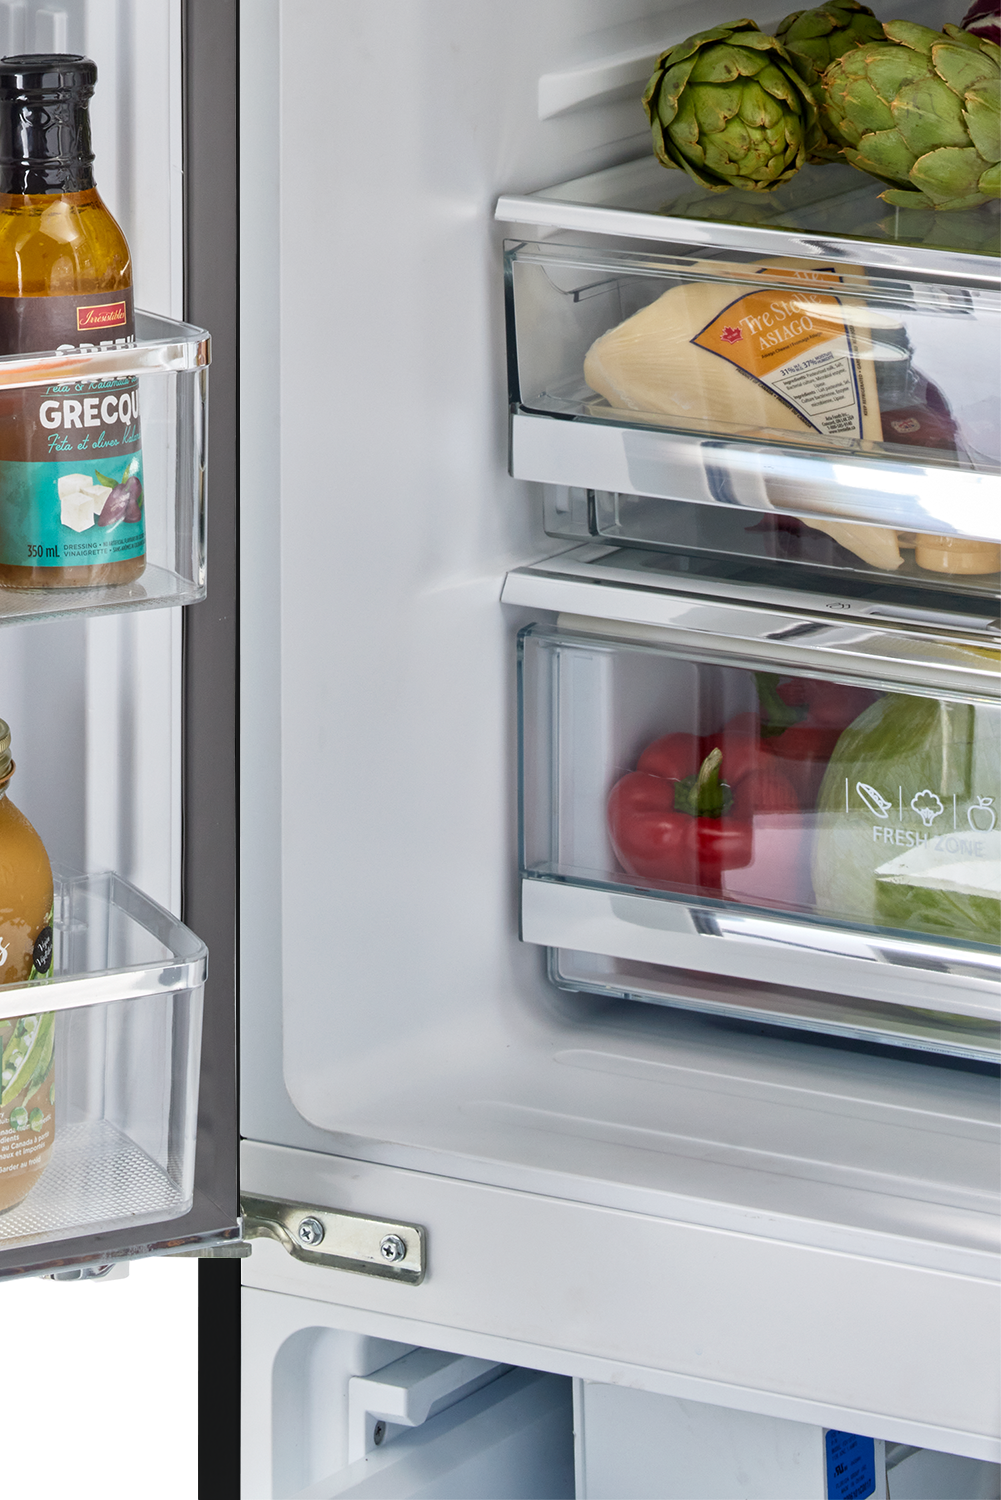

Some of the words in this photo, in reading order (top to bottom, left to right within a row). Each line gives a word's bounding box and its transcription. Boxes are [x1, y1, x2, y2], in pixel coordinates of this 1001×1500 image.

[739, 312, 774, 336] Tre
[758, 316, 814, 350] ASIAGO
[77, 434, 90, 450] et
[92, 430, 120, 448] olives
[28, 544, 44, 558] 350
[46, 544, 60, 558] mL
[64, 548, 108, 557] VINAIGRETTE
[872, 826, 928, 849] FRESH
[934, 836, 984, 858] ZONE
